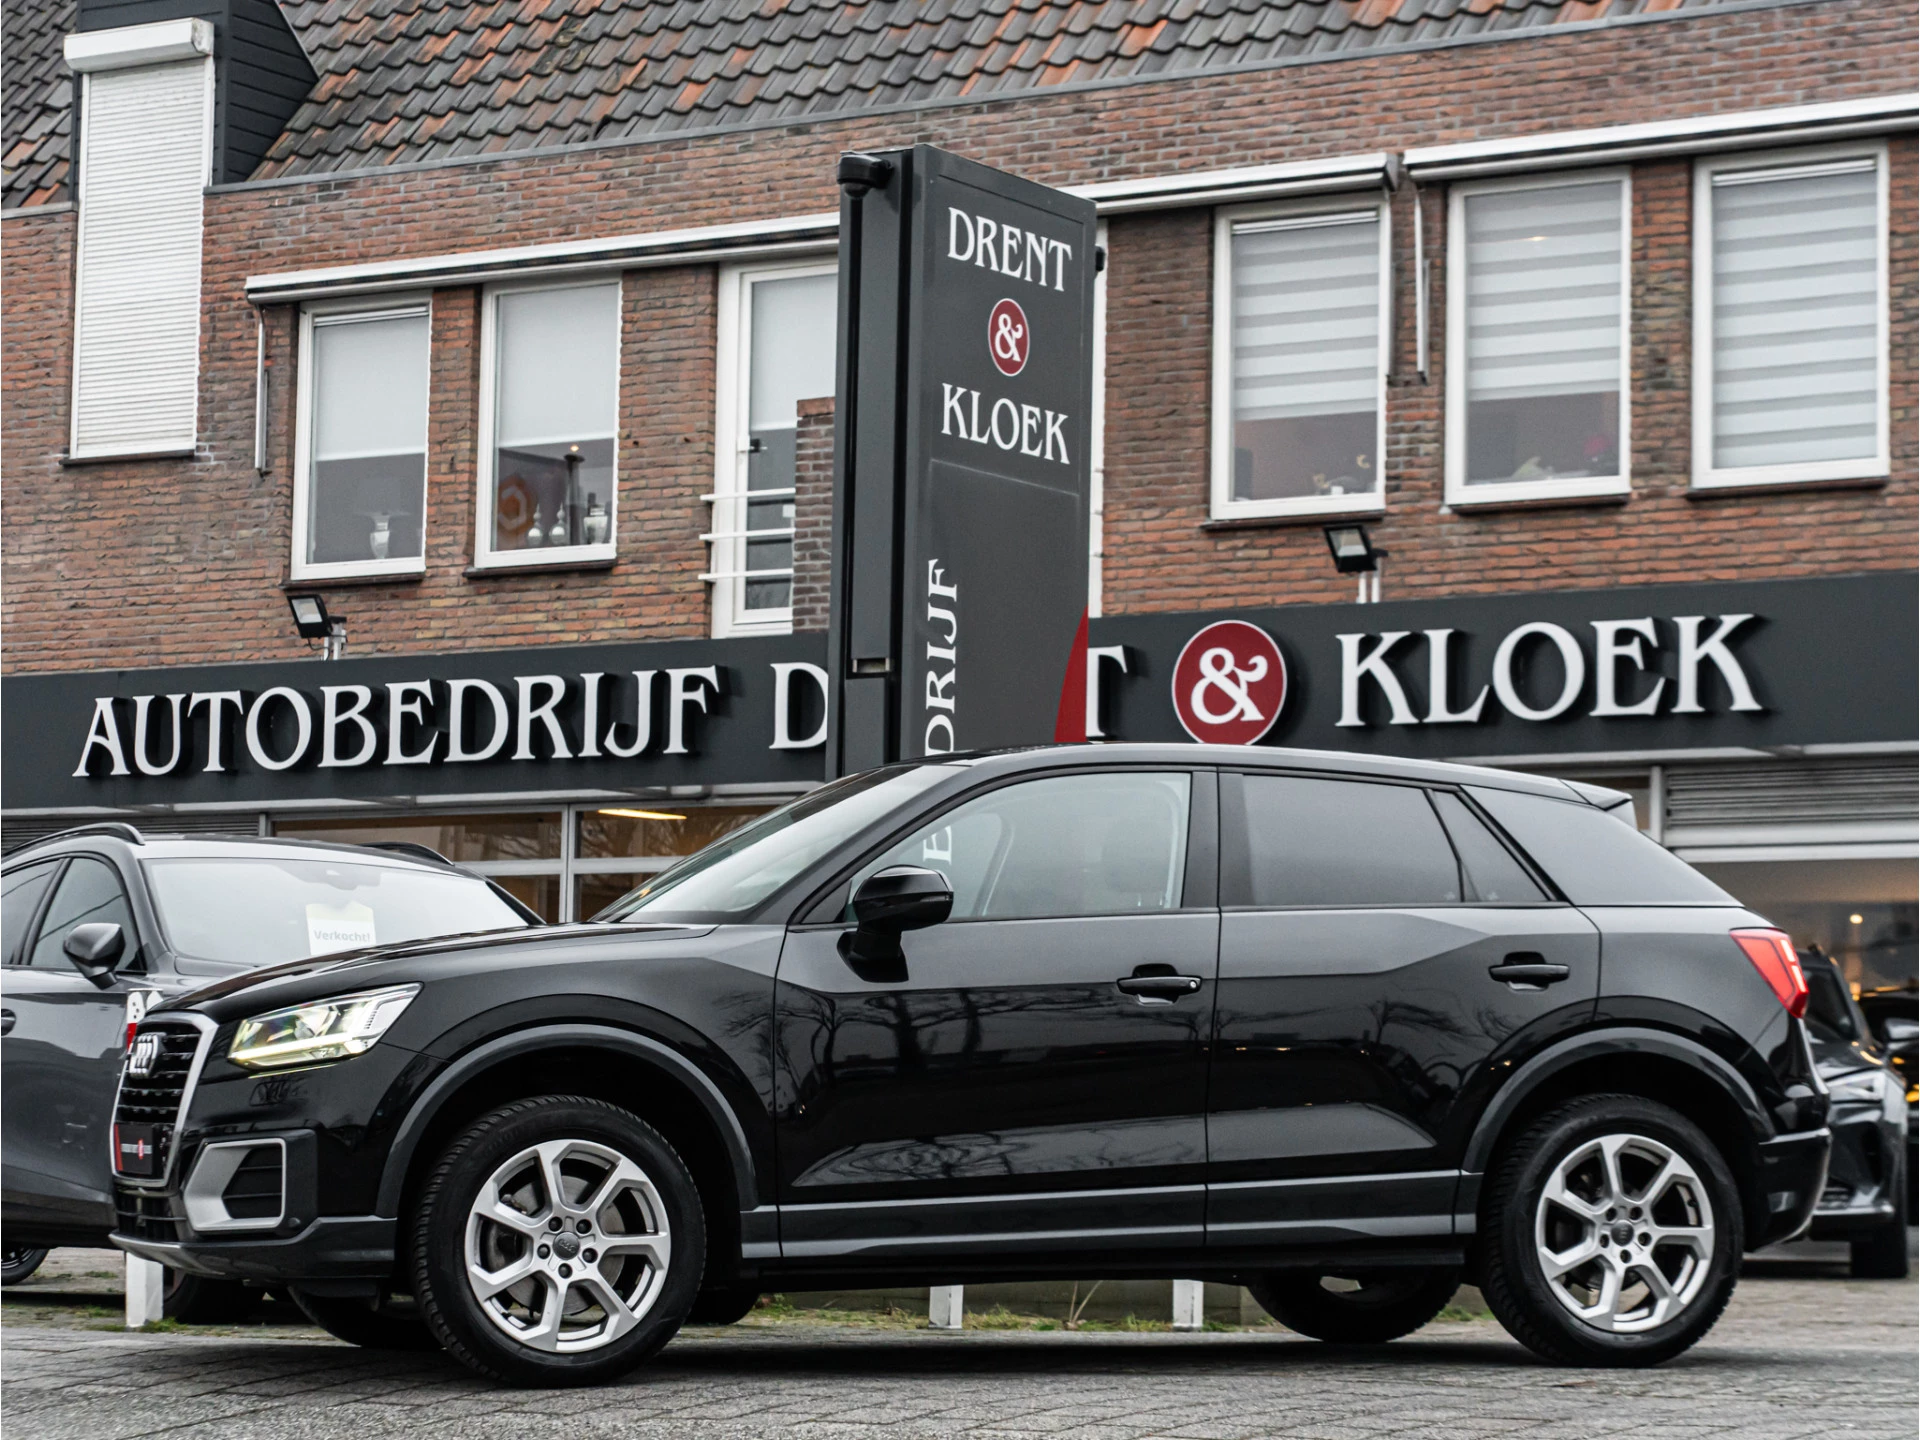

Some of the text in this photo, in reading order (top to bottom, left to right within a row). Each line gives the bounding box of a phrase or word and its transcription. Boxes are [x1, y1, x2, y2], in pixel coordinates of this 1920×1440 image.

[947, 206, 1073, 292] DRENT
[994, 313, 1024, 362] &
[941, 382, 1070, 465] KLOEK
[72, 665, 719, 777] AUTOBEDRIJF
[1190, 647, 1268, 725] &
[1335, 613, 1763, 727] KLOEK
[313, 930, 371, 943] Verkocht!
